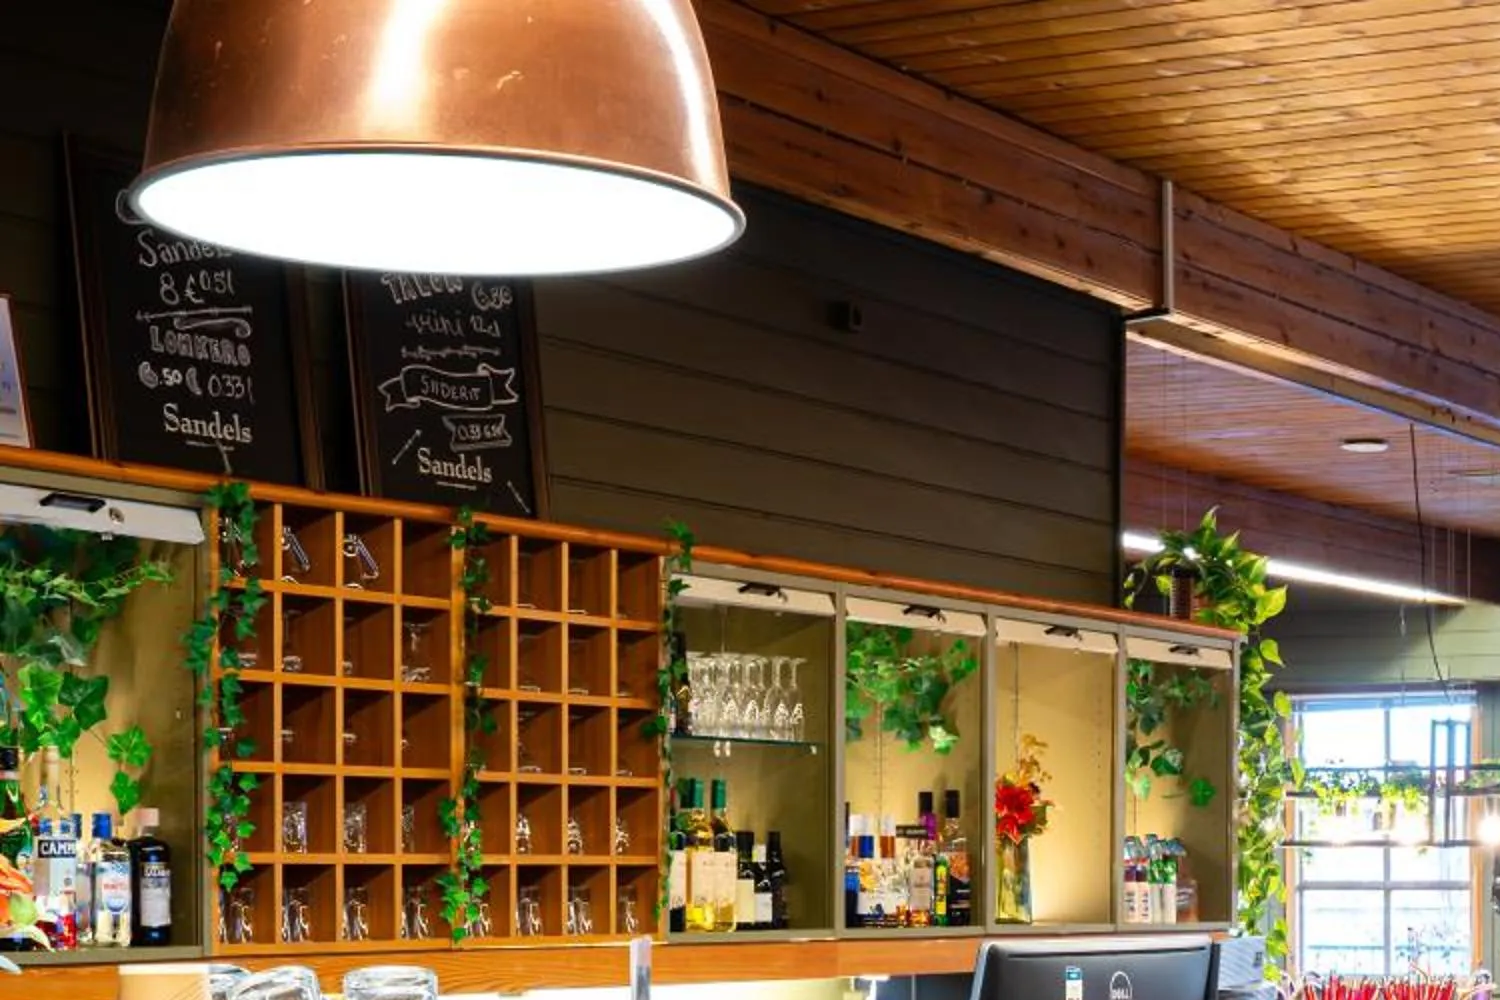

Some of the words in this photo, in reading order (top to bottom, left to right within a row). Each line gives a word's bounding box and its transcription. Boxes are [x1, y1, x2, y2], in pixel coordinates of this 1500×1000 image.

[160, 272, 179, 305] 8
[163, 403, 253, 443] Sandels
[417, 447, 493, 483] Sandels
